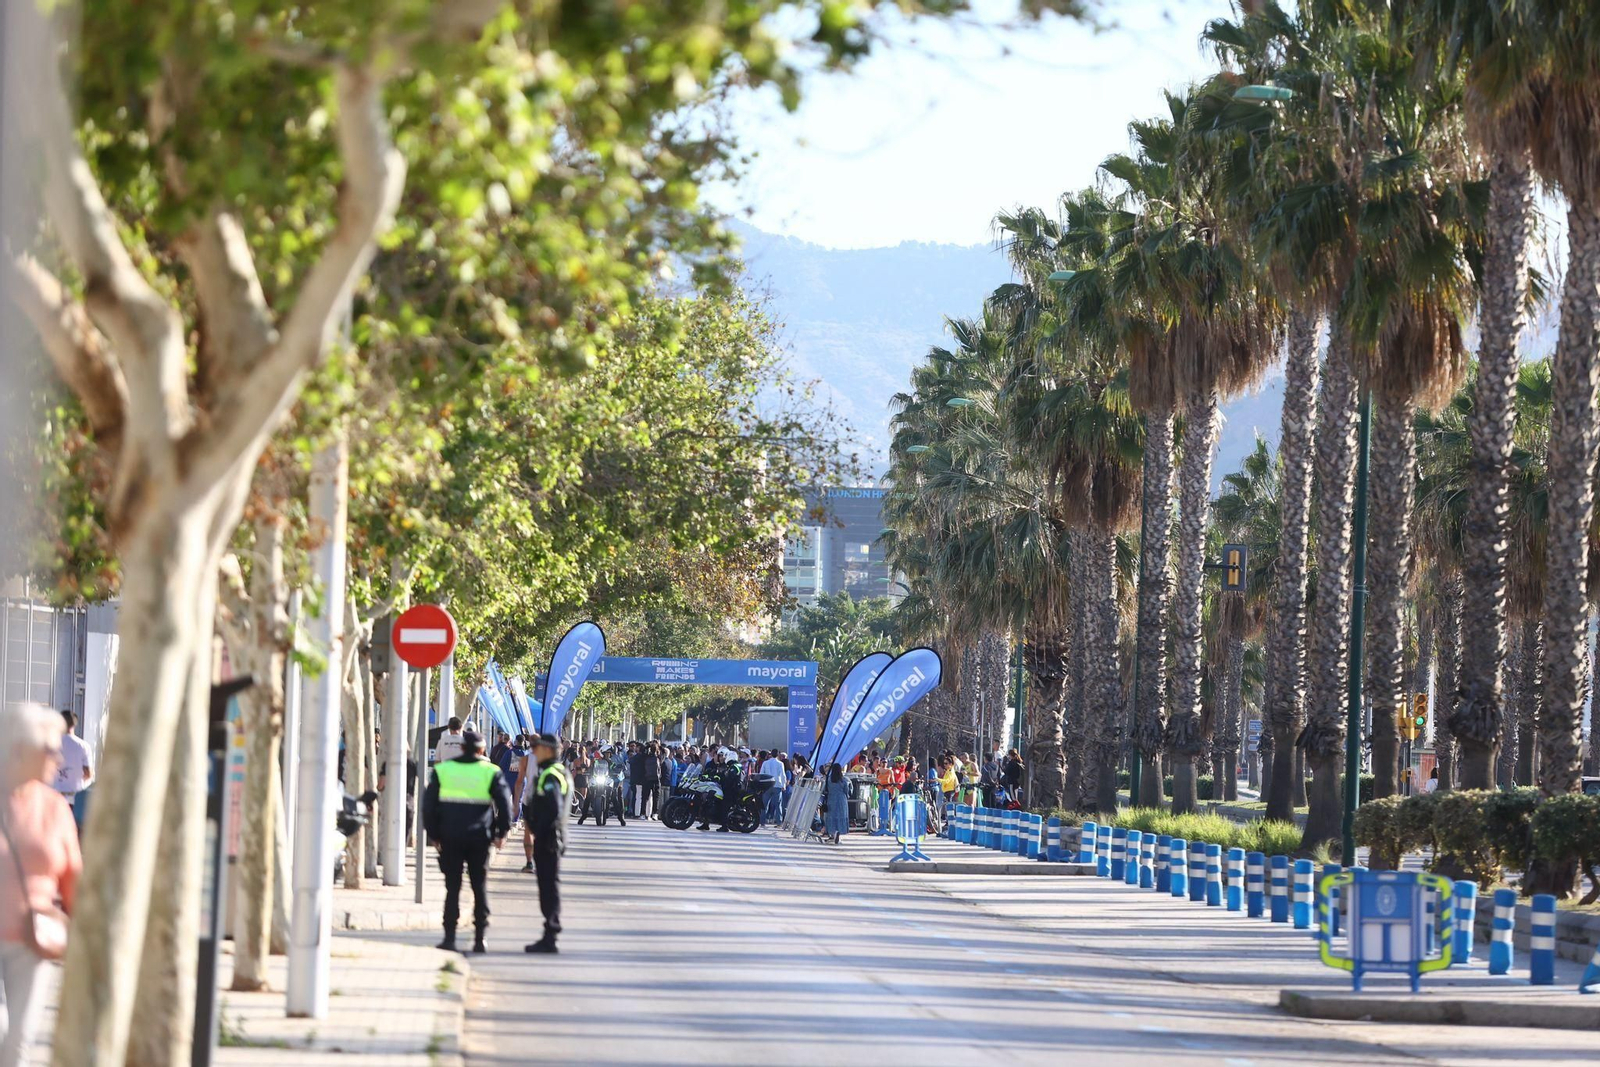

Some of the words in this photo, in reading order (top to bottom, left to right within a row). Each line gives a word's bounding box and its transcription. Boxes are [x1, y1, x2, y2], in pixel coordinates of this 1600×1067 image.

[549, 641, 592, 713] mayoral
[747, 665, 807, 680] mayoral
[860, 666, 925, 732] mayoral
